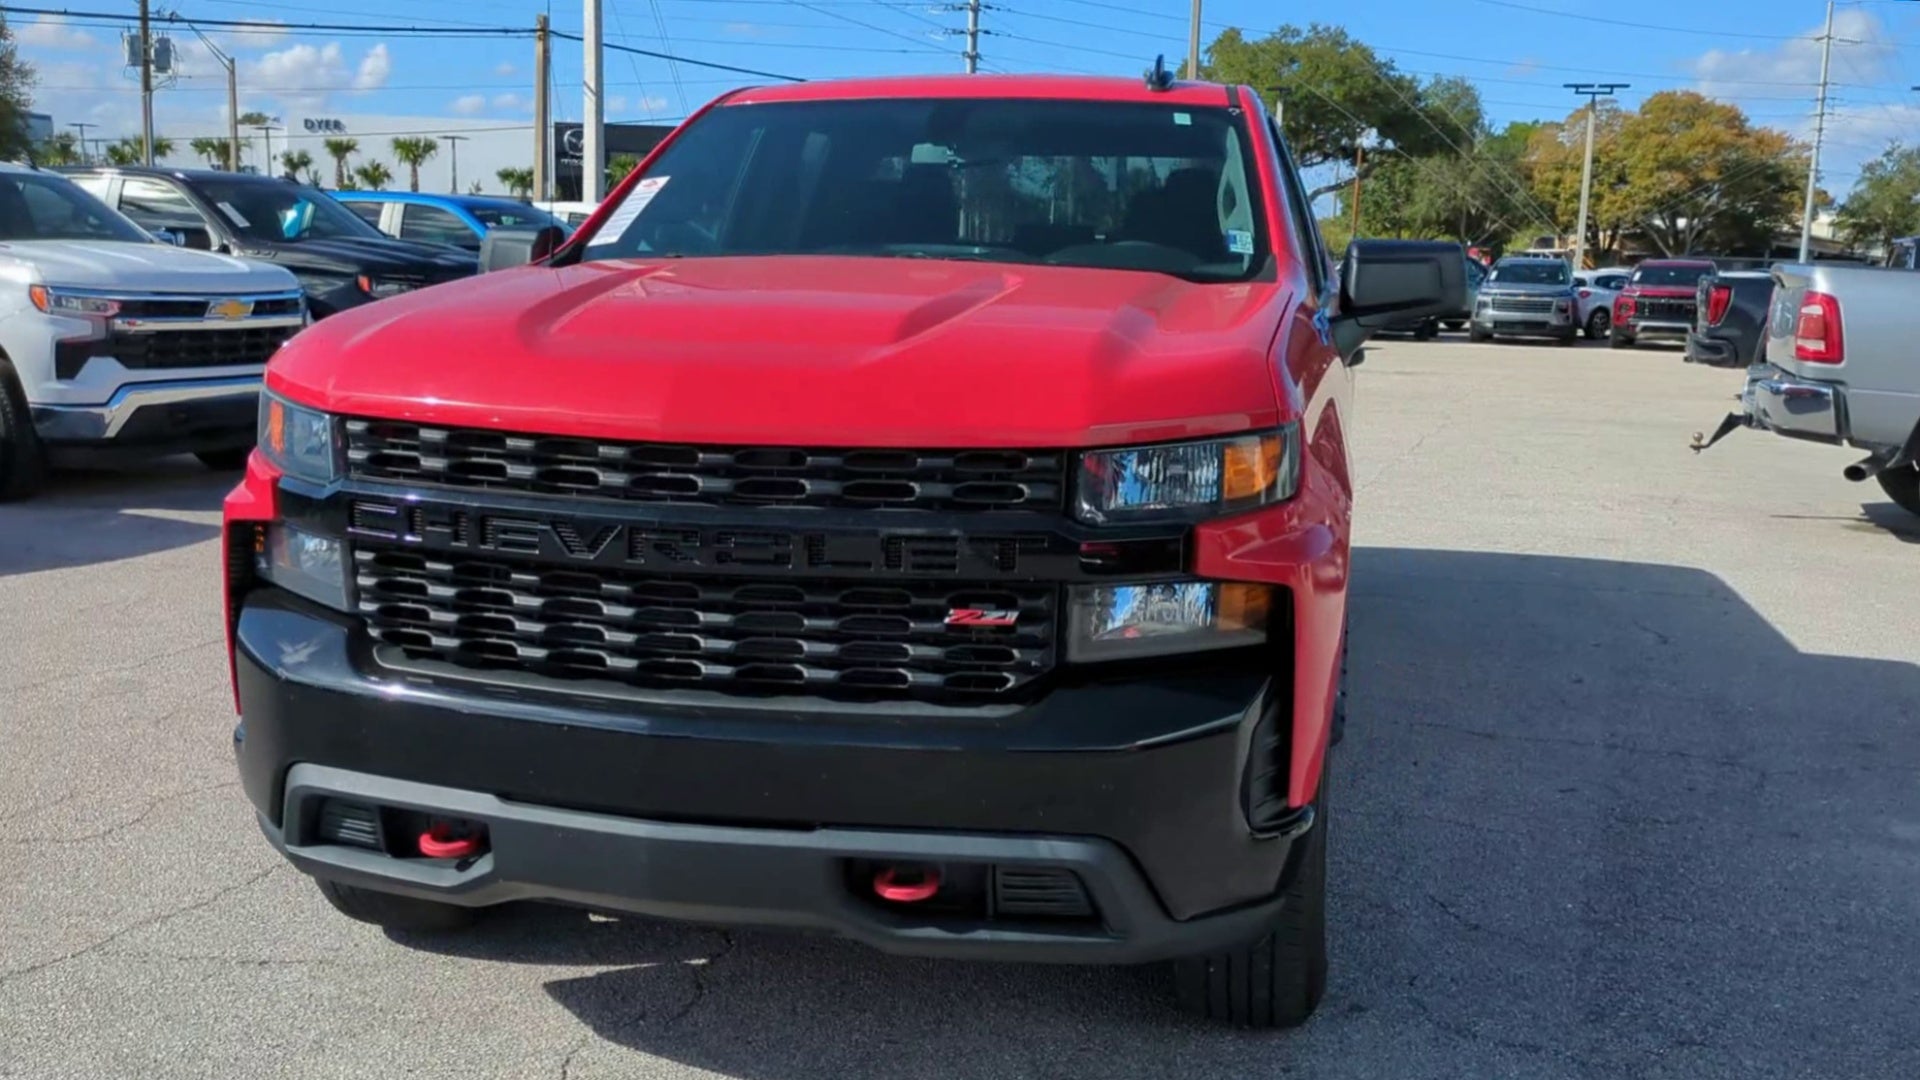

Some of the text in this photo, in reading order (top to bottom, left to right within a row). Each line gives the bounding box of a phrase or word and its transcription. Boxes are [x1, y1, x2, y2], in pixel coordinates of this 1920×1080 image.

[304, 118, 346, 131] DYER
[348, 501, 1048, 573] CHEVROLET
[944, 608, 1019, 625] Z71
